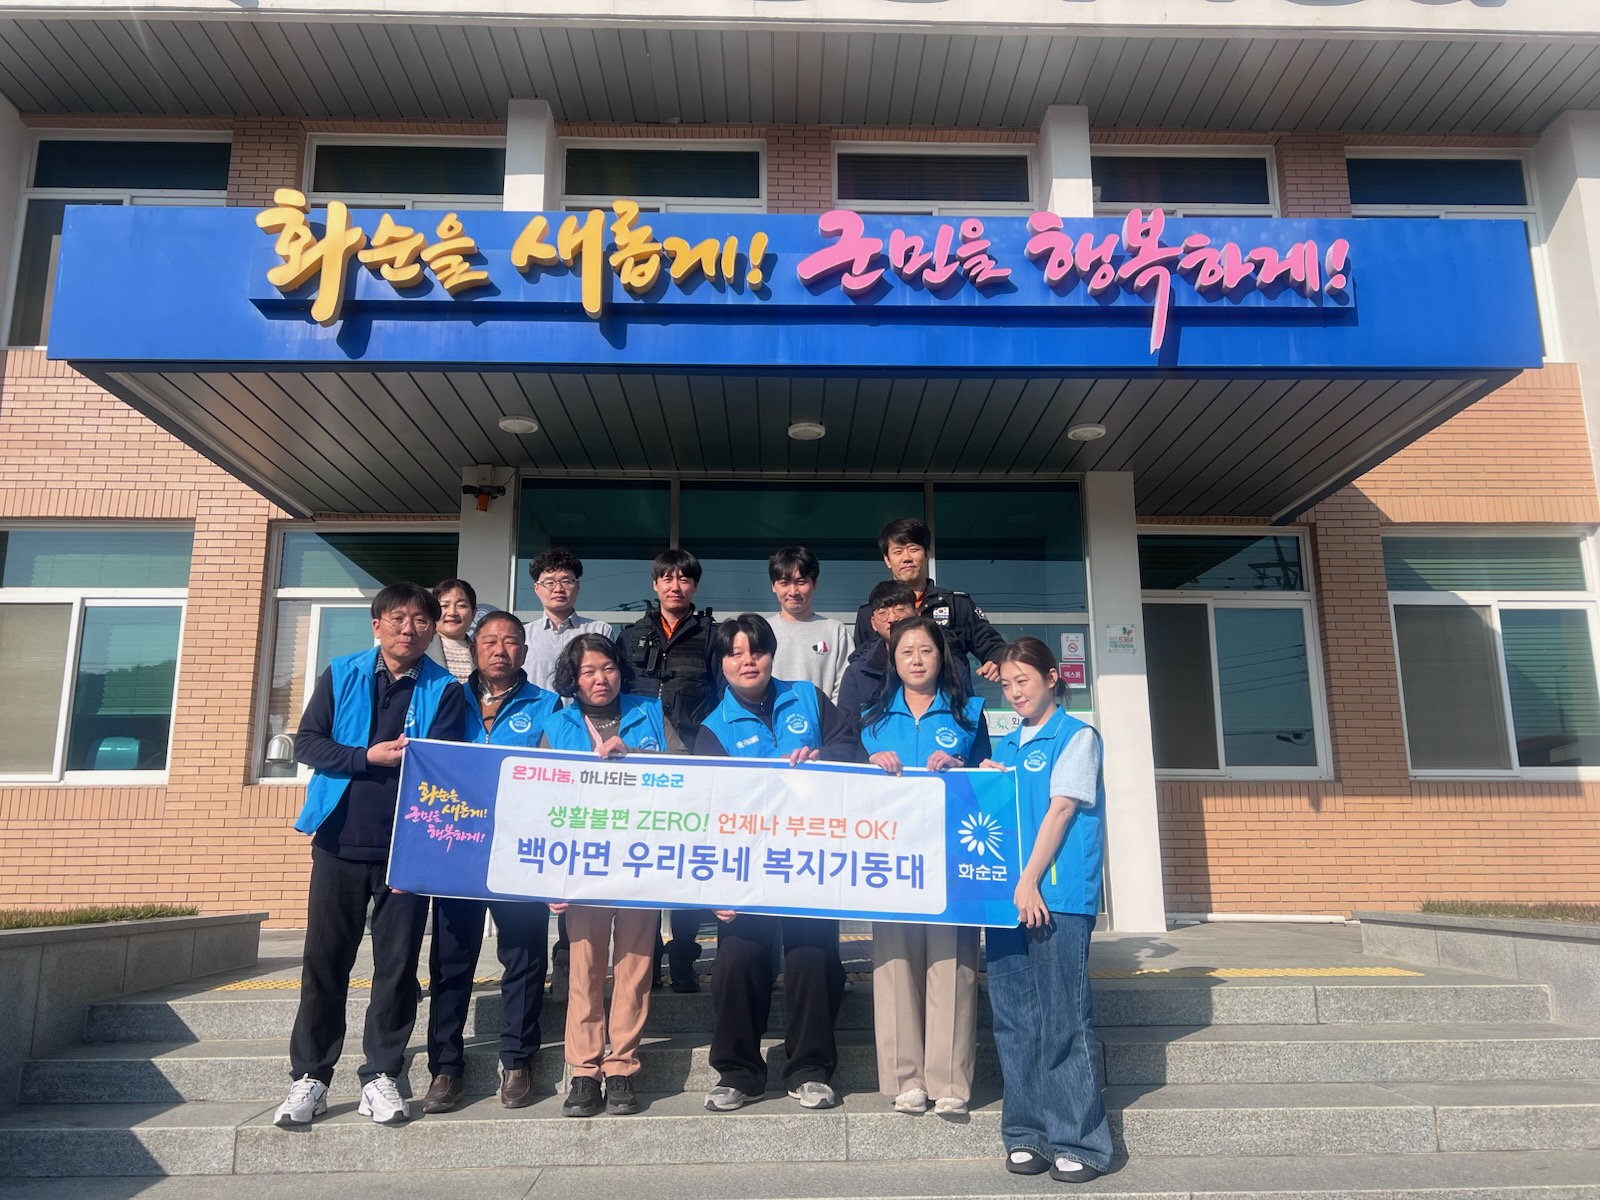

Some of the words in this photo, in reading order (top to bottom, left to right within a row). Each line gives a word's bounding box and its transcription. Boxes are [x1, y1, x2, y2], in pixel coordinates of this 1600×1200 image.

[255, 188, 491, 327] 화순을
[511, 199, 769, 319] 새롭게!
[796, 209, 1012, 297] 군민을
[1026, 207, 1350, 355] 행복하게!
[511, 764, 575, 785] 온기나눔,
[579, 769, 637, 787] 하나되는
[640, 771, 685, 789] 화순군
[418, 781, 460, 806] 화순을
[404, 805, 443, 823] 군민을
[441, 801, 488, 822] 새롭게!
[547, 805, 631, 831] 생활불편
[635, 810, 711, 833] ZERO!
[717, 812, 780, 836] 언제나
[785, 815, 848, 840] 부르면
[854, 819, 899, 841] OK!
[426, 823, 486, 853] 행복하게!
[517, 837, 611, 877] 백아면
[622, 841, 751, 883] 우리동네
[762, 847, 925, 890] 복지기동대
[957, 862, 1008, 882] 화순군
